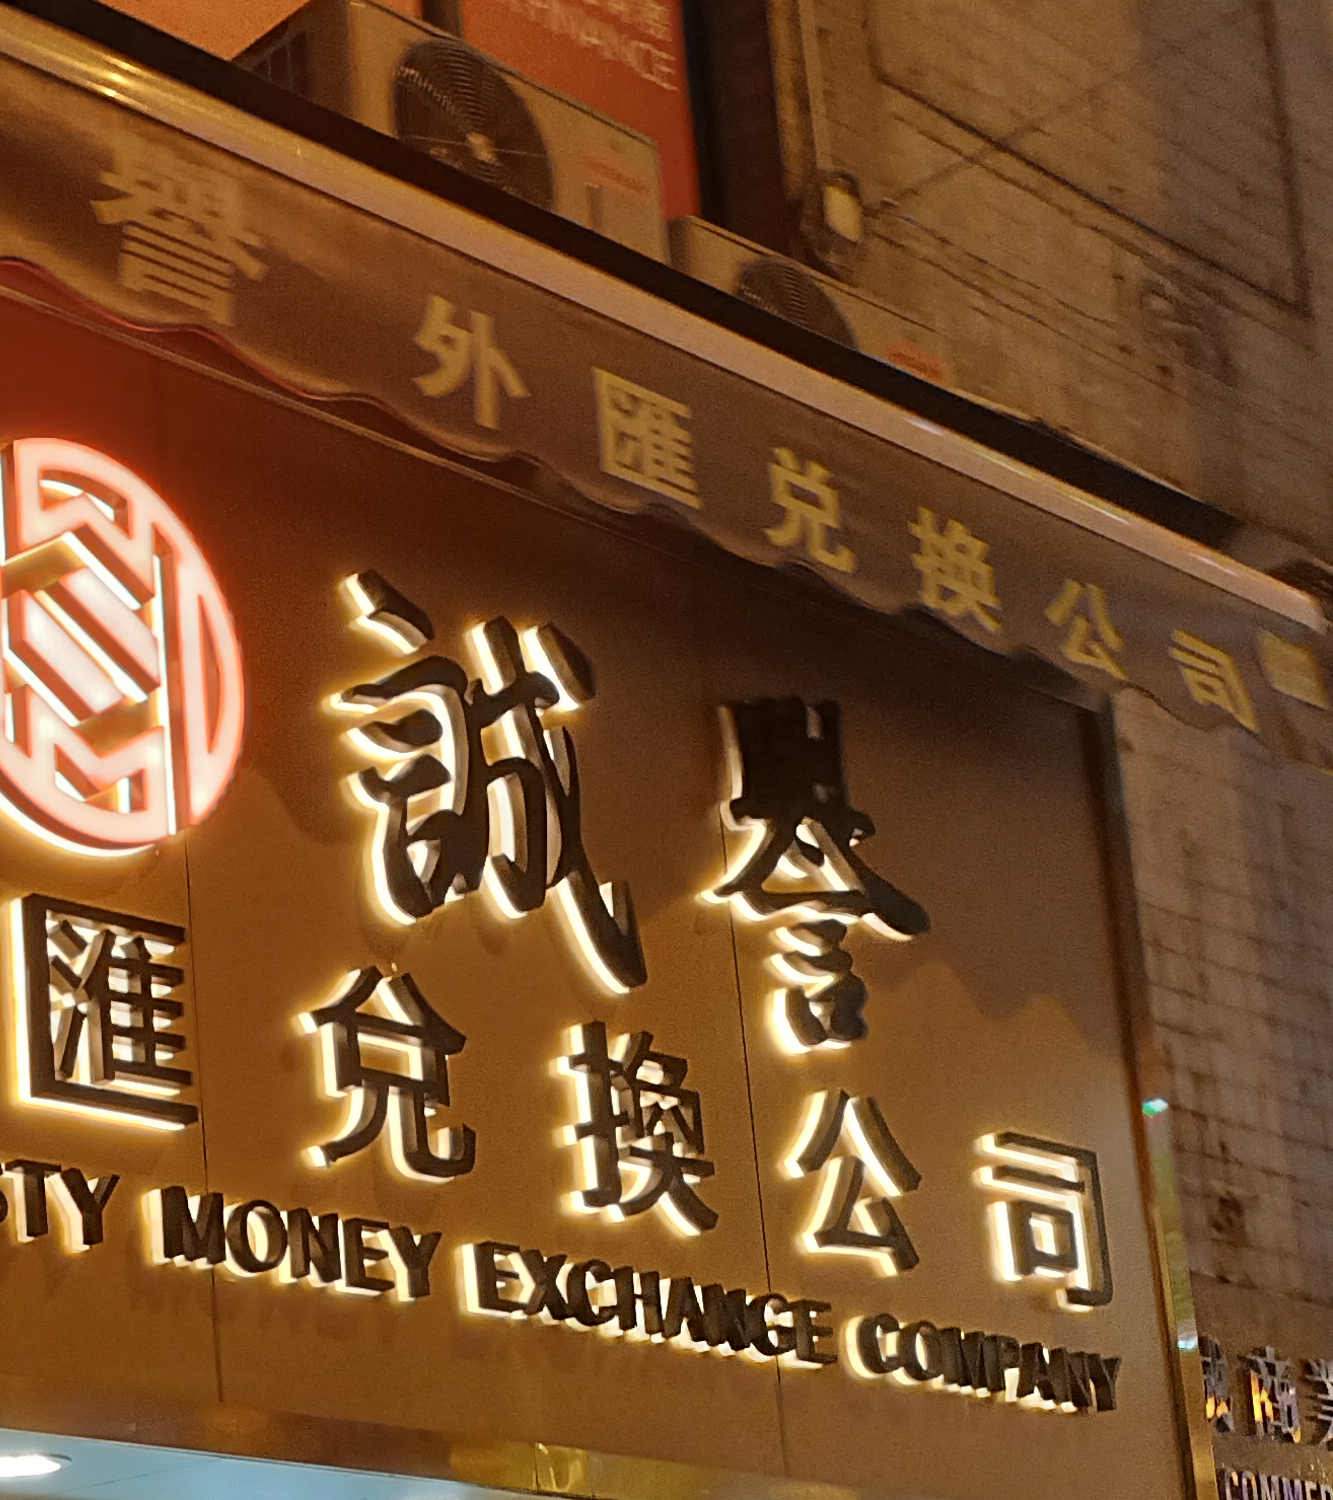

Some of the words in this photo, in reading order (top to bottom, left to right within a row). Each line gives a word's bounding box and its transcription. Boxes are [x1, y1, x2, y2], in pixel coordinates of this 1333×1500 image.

[323, 570, 930, 1056] 誠譽
[147, 1186, 442, 1303] MONEY
[462, 1240, 836, 1368] EXCHANGE
[846, 1311, 1122, 1414] COMPANY
